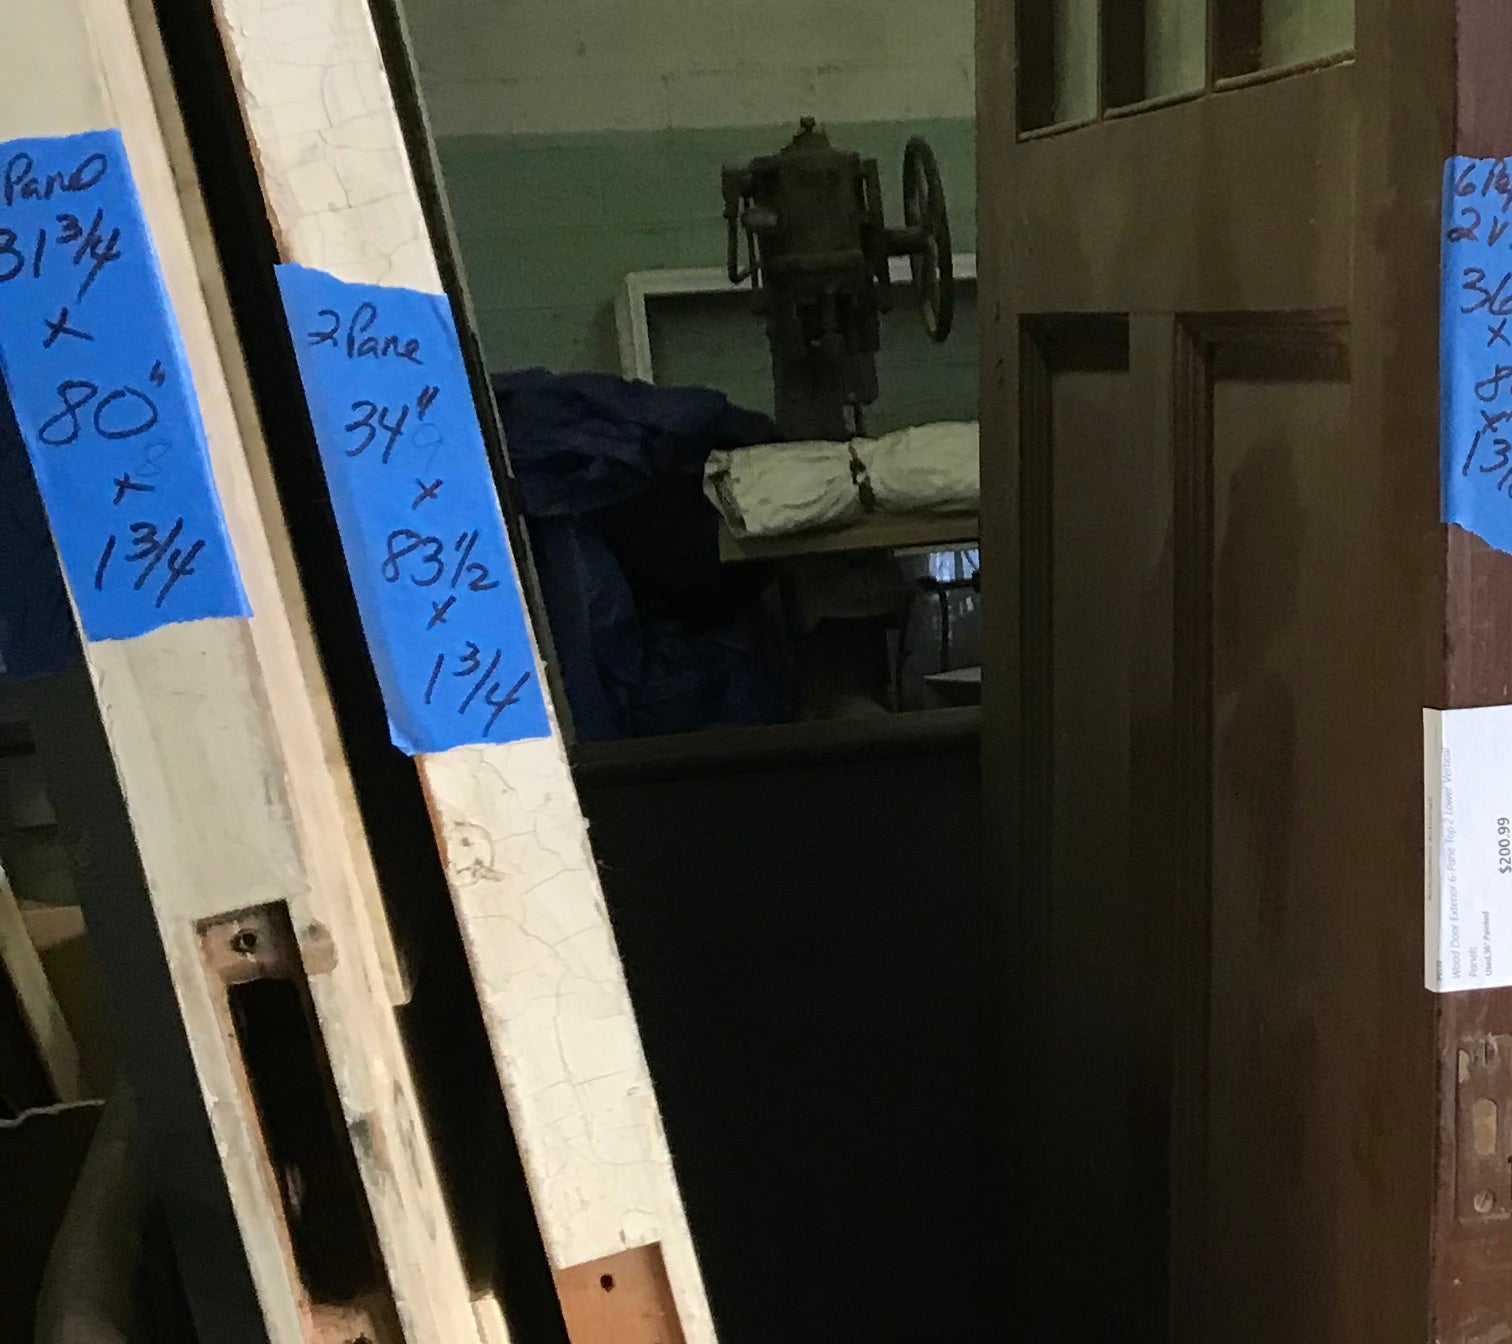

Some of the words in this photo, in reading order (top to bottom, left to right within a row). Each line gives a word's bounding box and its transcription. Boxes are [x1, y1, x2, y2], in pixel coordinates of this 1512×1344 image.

[1456, 162, 1476, 196] 6
[1447, 207, 1481, 243] 2
[56, 207, 121, 305] 3/4
[308, 310, 340, 347] 2
[126, 517, 205, 608] 3/4
[381, 528, 444, 588] 83
[450, 530, 500, 591] 1/2
[454, 641, 531, 737] 3/4
[1497, 817, 1512, 874] $200.99
